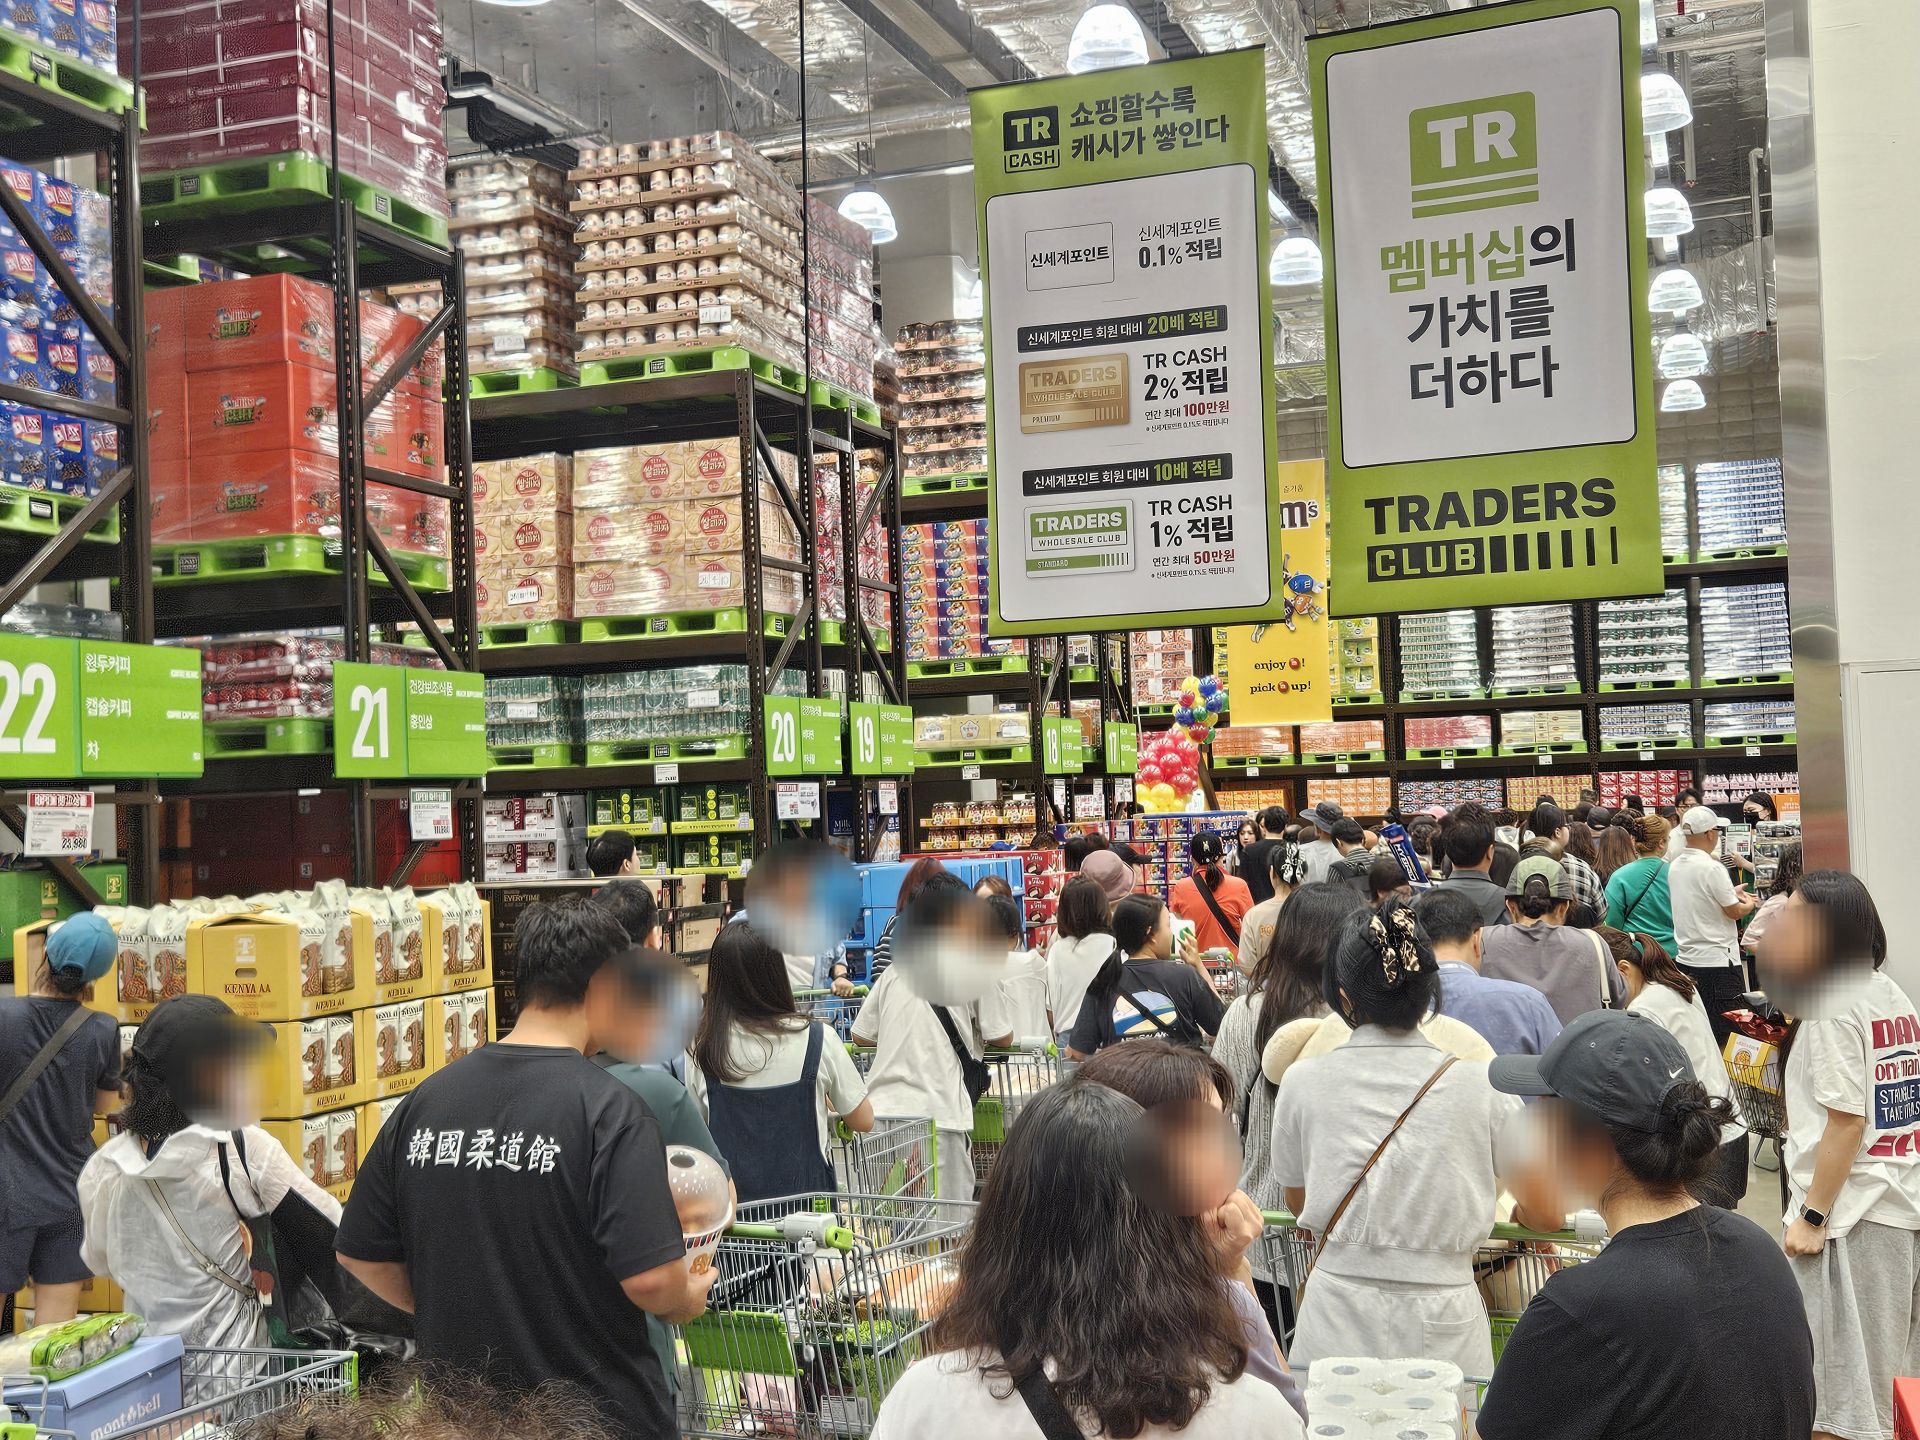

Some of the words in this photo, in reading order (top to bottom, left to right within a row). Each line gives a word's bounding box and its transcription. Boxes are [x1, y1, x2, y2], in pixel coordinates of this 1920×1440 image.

[1070, 85, 1196, 128] 쇼핑할수록
[1010, 115, 1052, 143] TR
[1071, 127, 1145, 162] 캐시가
[1152, 114, 1230, 152] 쌓인다
[1426, 110, 1519, 169] TR
[1009, 150, 1055, 168] CASH
[1138, 217, 1222, 241] 신세계포인트
[1030, 246, 1110, 268] 신세계포인트
[1138, 246, 1183, 269] 0.1%
[1185, 237, 1222, 261] 적립
[1380, 218, 1577, 295] 멤버십의
[1027, 328, 1093, 346] 신세계포인트
[1096, 324, 1118, 339] 회원
[1120, 321, 1143, 336] 대비
[1147, 312, 1185, 335] 20배
[1189, 309, 1218, 329] 적립
[1407, 284, 1555, 348] 가치를
[1143, 353, 1167, 370] TR
[1172, 346, 1227, 366] CASH
[1030, 366, 1117, 388] TRADERS
[1144, 374, 1179, 401] 2%
[1182, 366, 1228, 396] 적립
[1410, 344, 1560, 409] 더하다
[1145, 410, 1161, 420] 연간
[1164, 407, 1181, 418] 최대
[1183, 400, 1229, 417] 100만원
[699, 458, 726, 472] 쌀과자
[1034, 472, 1100, 489] 신세계포인트
[1102, 469, 1126, 484] 회원
[1127, 467, 1149, 482] 대비
[1153, 461, 1187, 482] 10배
[1192, 458, 1222, 477] 적립
[1148, 501, 1172, 517] TR
[1178, 495, 1232, 515] CASH
[1365, 477, 1617, 535] TRADERS
[700, 515, 727, 530] 쌀과자
[1035, 512, 1122, 533] TRADERS
[1150, 521, 1183, 547] 1%
[1187, 517, 1234, 544] 적립
[1039, 536, 1093, 547] WHOLESALE
[1097, 534, 1121, 543] CLUB
[1152, 556, 1169, 567] 연간
[1172, 554, 1190, 565] 최대
[1193, 549, 1235, 564] 50만원
[1375, 541, 1477, 577] CLUB
[85, 653, 131, 675] 원두커피
[1254, 660, 1286, 674] enjoy
[1250, 682, 1276, 695] pick
[1291, 681, 1311, 693] up!
[0, 660, 56, 754] 22
[86, 697, 132, 718] 캡슐커피
[350, 685, 389, 757] 21
[86, 740, 100, 761] 차
[771, 712, 795, 763] 20
[856, 716, 875, 763] 19
[1047, 728, 1058, 765] 18
[224, 983, 257, 994] KENYA
[259, 983, 271, 993] AA
[134, 1009, 149, 1017] KEN
[406, 1127, 562, 1175] 韓國柔道館
